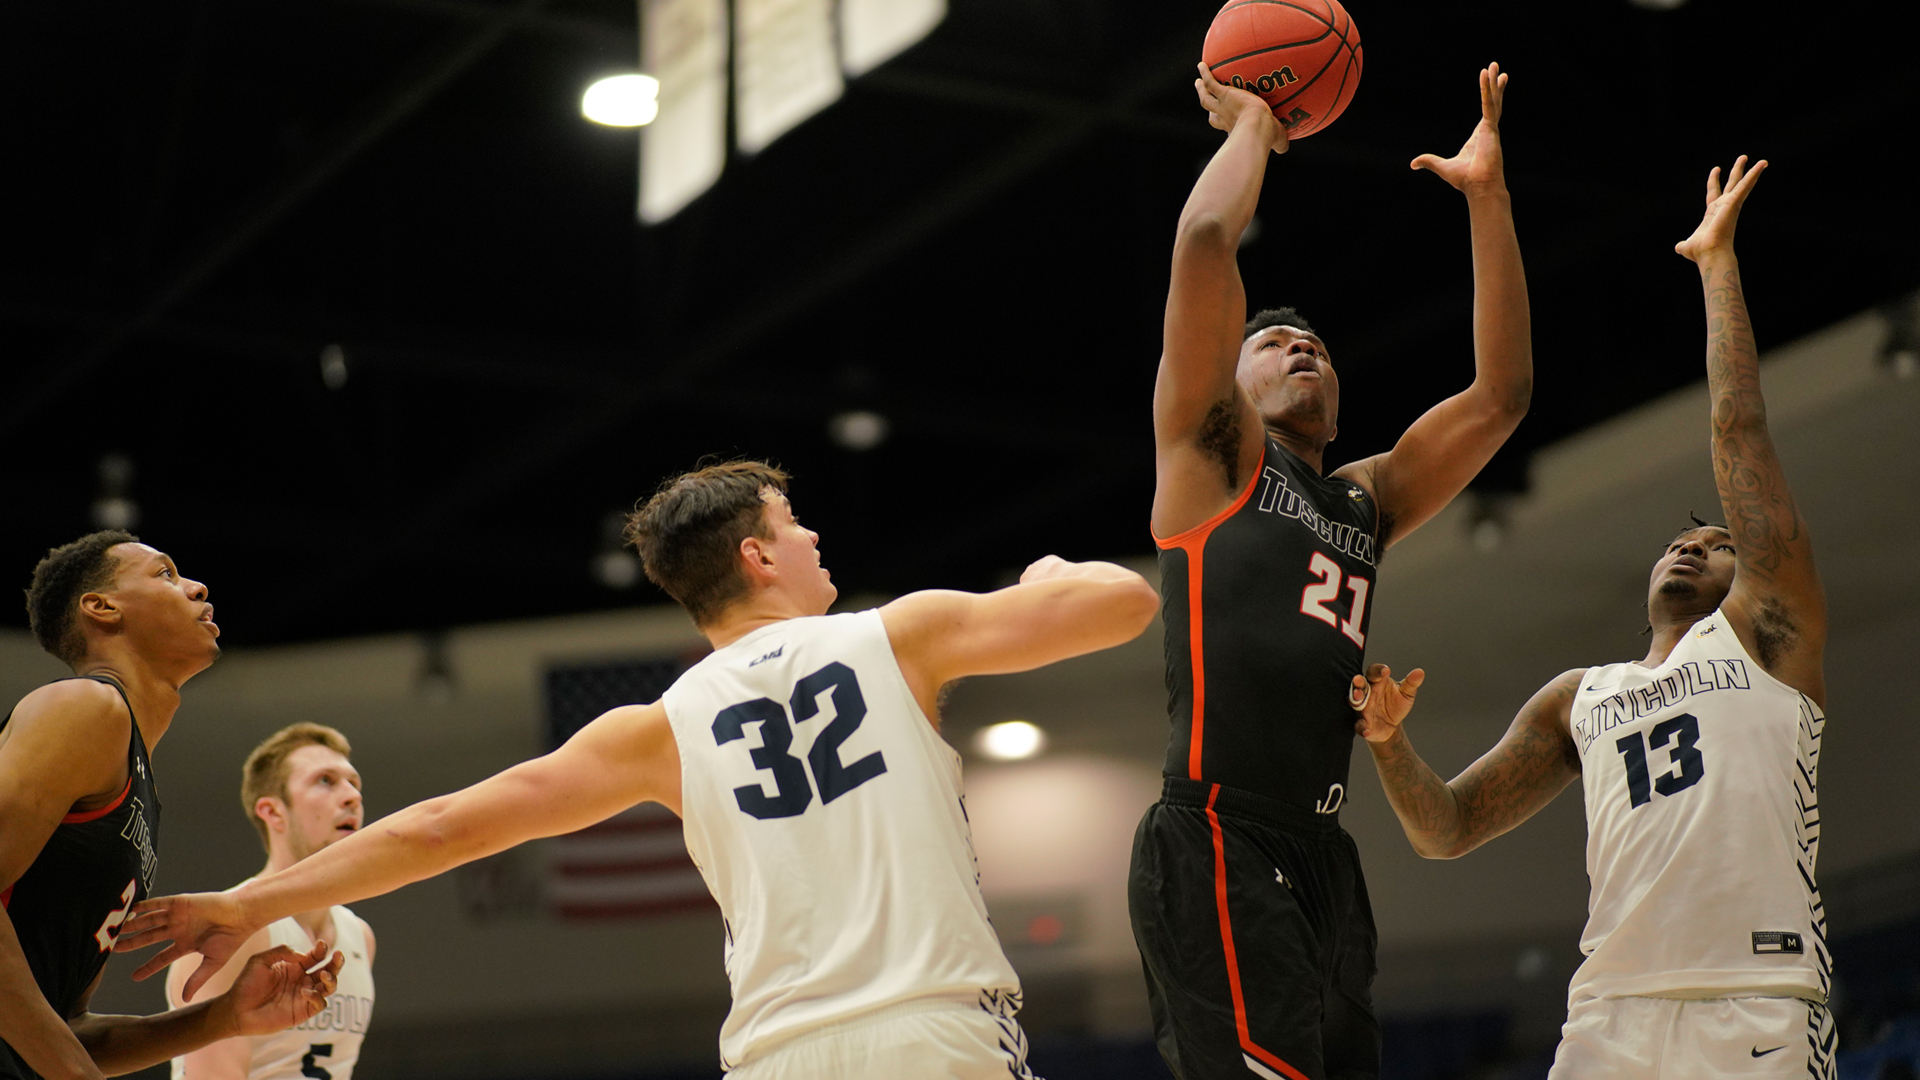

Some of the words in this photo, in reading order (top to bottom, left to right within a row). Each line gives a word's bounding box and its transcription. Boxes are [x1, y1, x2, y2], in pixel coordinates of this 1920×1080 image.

[1299, 550, 1370, 651] 21
[710, 660, 888, 820] 32
[1575, 658, 1751, 756] LINCOLN
[1615, 712, 1705, 810] 13
[1787, 937, 1797, 948] M
